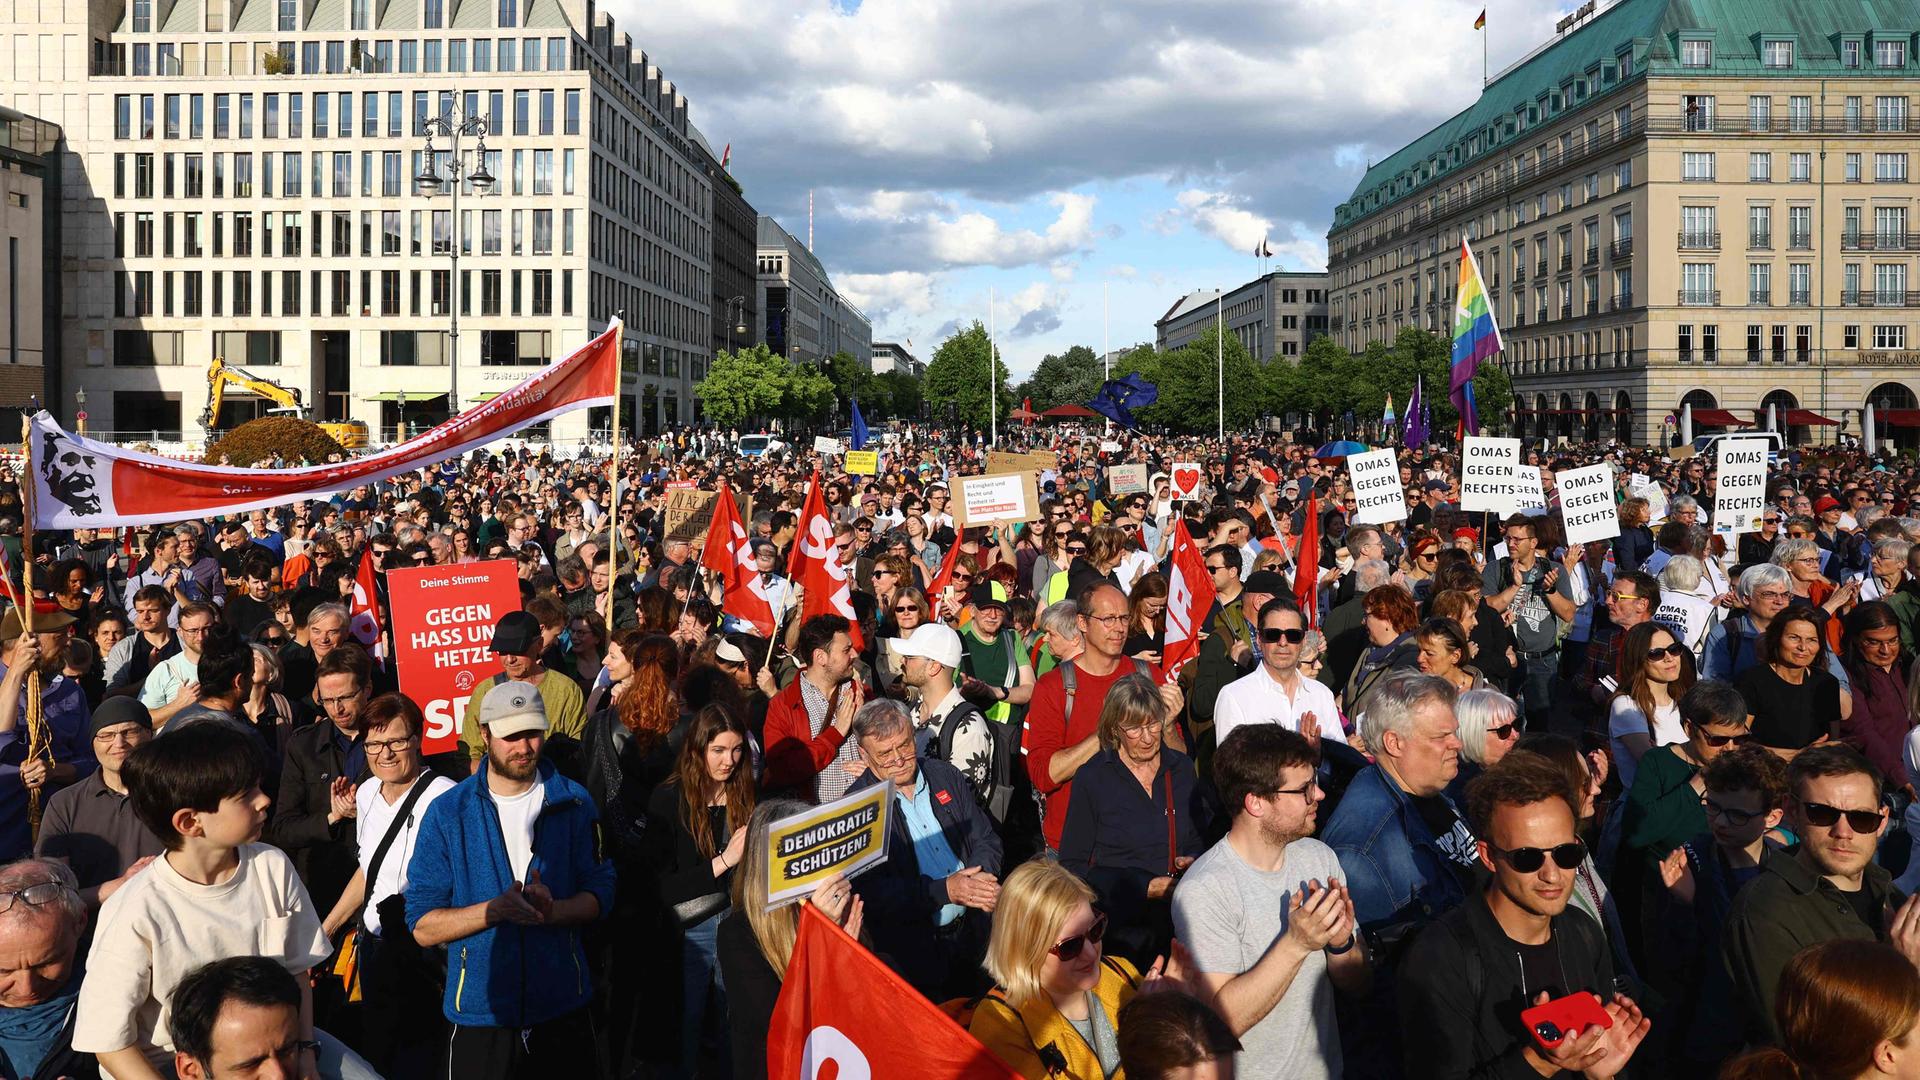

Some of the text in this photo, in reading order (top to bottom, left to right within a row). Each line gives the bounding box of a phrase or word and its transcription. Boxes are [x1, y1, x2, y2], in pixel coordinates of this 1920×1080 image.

[1858, 352, 1920, 365] HOTEL ADLO
[1470, 446, 1512, 458] OMAS
[1725, 451, 1762, 464] OMAS
[1355, 457, 1391, 473] OMAS
[1467, 465, 1513, 476] GEGEN
[1357, 475, 1396, 491] GEGEN
[1464, 483, 1515, 495] RECHTS
[1564, 473, 1604, 490] OMAS
[1721, 474, 1762, 488] GEGEN
[671, 492, 712, 509] NAZIS
[1358, 493, 1402, 509] RECHTS
[1565, 490, 1609, 508] GEGEN
[1718, 496, 1762, 511] RECHTS
[1566, 508, 1616, 527] RECHTS
[420, 574, 489, 588] Deine Stimme
[426, 604, 492, 626] GEGEN
[1660, 605, 1688, 616] OMAS
[1654, 614, 1687, 624] GEGEN
[411, 624, 496, 649] HASS UN
[434, 646, 493, 669] HETZE
[784, 807, 874, 854] DEMOKRATIE
[790, 833, 868, 876] SCHÜTZEN!
